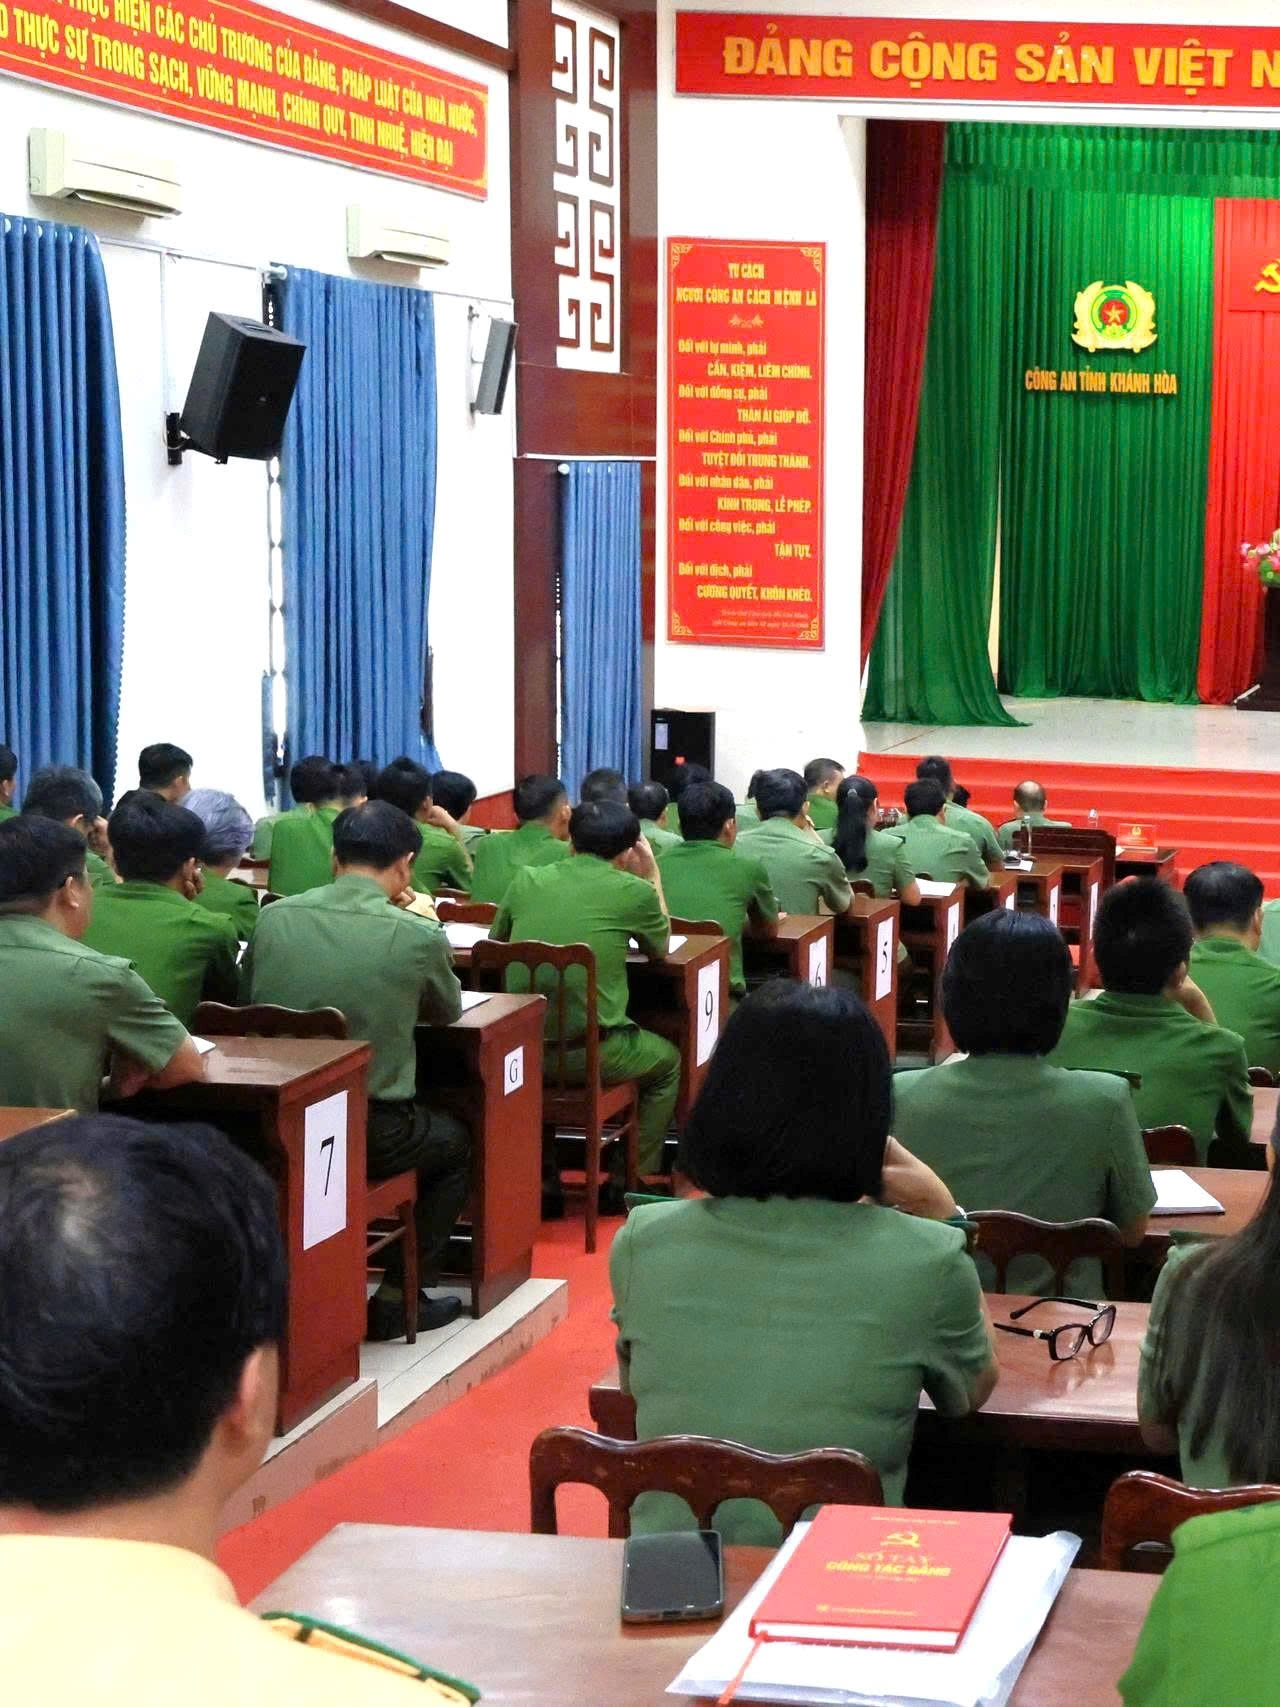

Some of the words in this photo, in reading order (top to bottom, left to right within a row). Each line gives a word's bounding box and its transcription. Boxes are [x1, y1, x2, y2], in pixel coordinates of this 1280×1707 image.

[155, 2, 185, 45] CÁC
[189, 13, 217, 55] CHỦ
[220, 26, 273, 73] TRƯƠNG
[276, 38, 301, 81] CỦA
[722, 22, 854, 77] ĐẢNG
[869, 31, 998, 89] CỘNG
[1015, 31, 1115, 84] SẢN
[1133, 38, 1233, 95] VIỆT
[13, 7, 60, 59] THỰC
[64, 24, 89, 71] SỰ
[92, 32, 145, 81] TRONG
[149, 51, 194, 99] SẠCH,
[196, 63, 234, 106] VỮNG
[237, 78, 280, 121] MẠNH,
[283, 90, 321, 129] CHÍNH
[1024, 366, 1057, 391] CÔNG
[1060, 370, 1077, 392] AN
[1079, 365, 1106, 392] TỈNH
[1110, 368, 1150, 394] KHÁNH
[1153, 369, 1178, 395] HÒA
[881, 941, 888, 974] 5
[704, 990, 714, 1033] 9
[509, 1059, 519, 1084] G
[320, 1136, 335, 1196] 7
